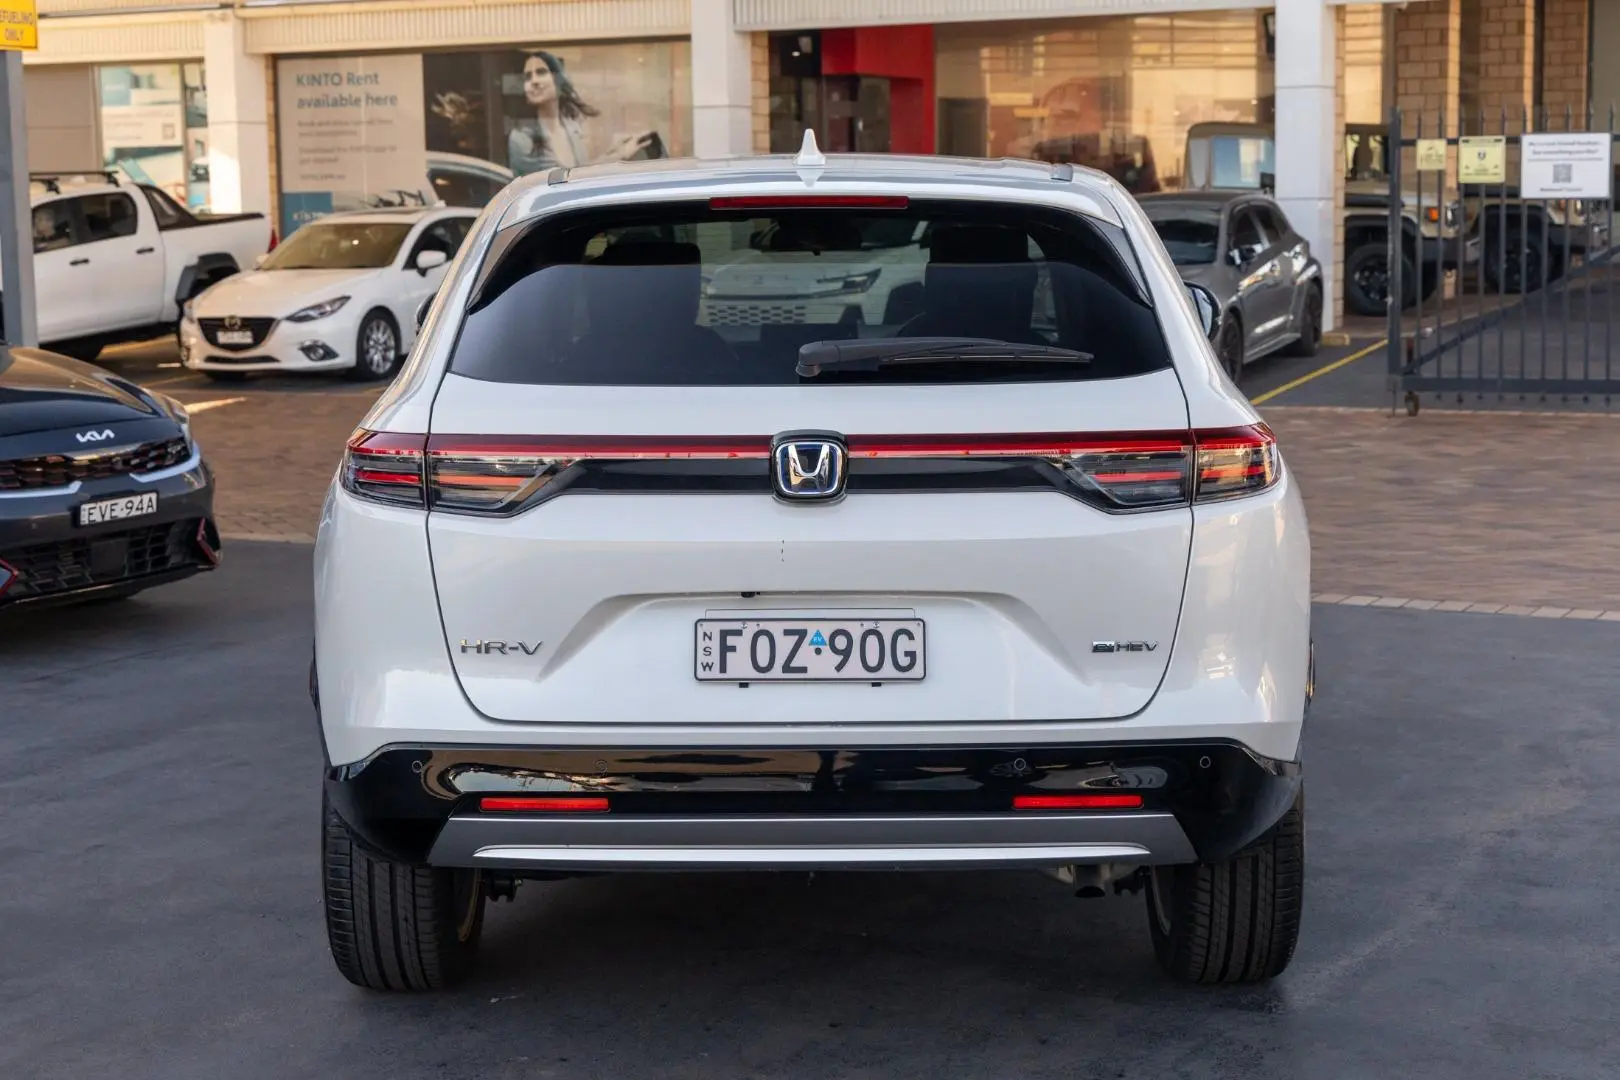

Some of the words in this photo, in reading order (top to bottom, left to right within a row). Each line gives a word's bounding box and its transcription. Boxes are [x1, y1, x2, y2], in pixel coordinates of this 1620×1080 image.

[296, 72, 343, 87] KINTO
[346, 71, 380, 85] Rent
[297, 93, 362, 109] available
[365, 91, 398, 107] here
[460, 639, 543, 655] HR-V
